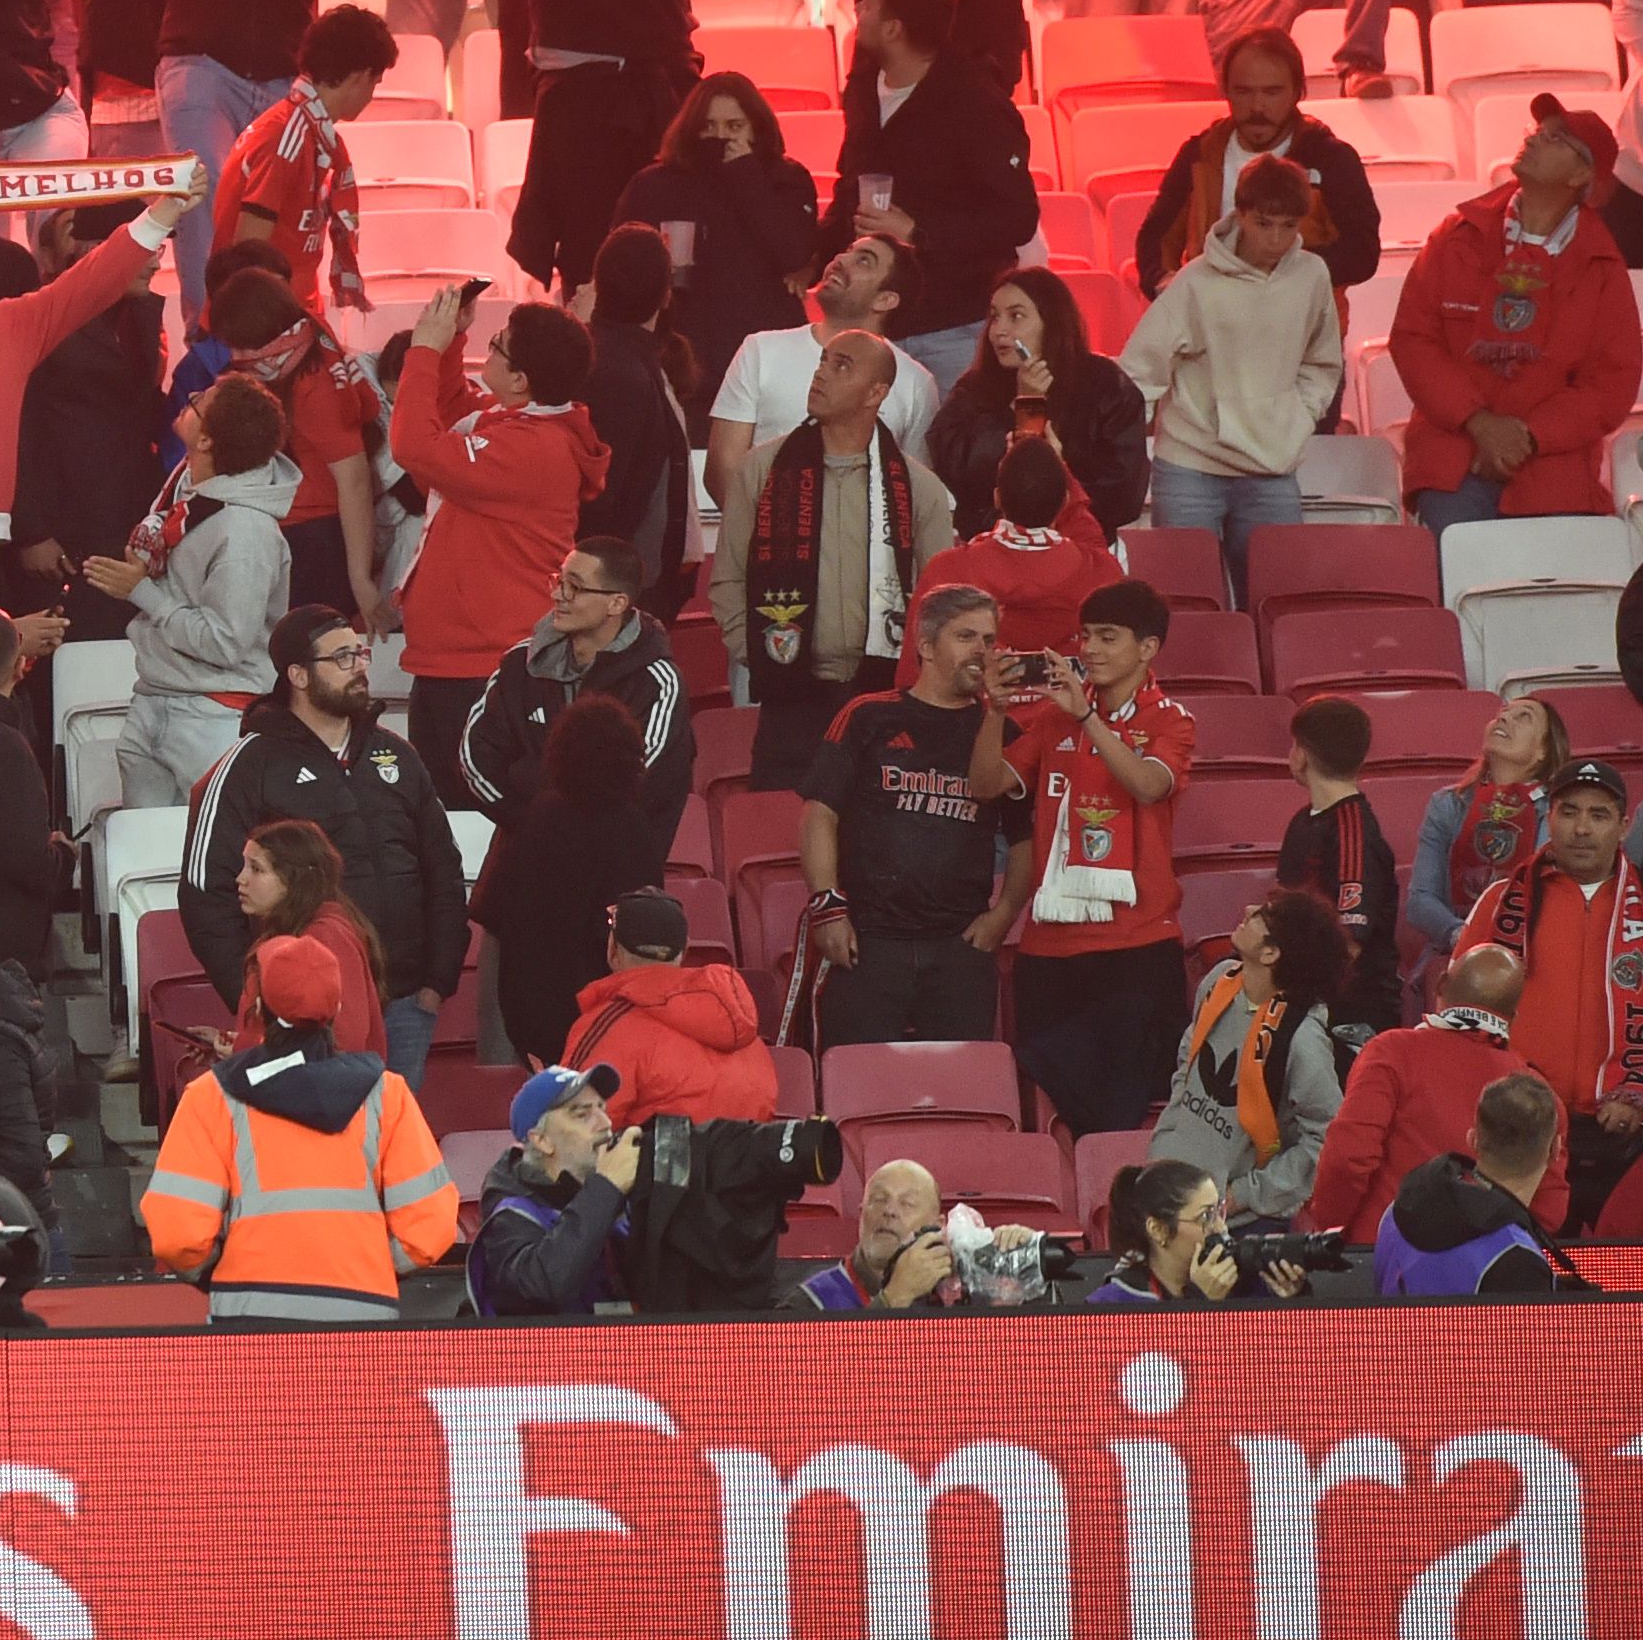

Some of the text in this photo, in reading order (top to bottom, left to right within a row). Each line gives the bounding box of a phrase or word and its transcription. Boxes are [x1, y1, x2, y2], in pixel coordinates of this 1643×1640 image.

[881, 765, 971, 799] Emira
[896, 792, 977, 823] FLY BETTER
[1180, 1089, 1235, 1141] adidas
[421, 1350, 1643, 1640] Emira
